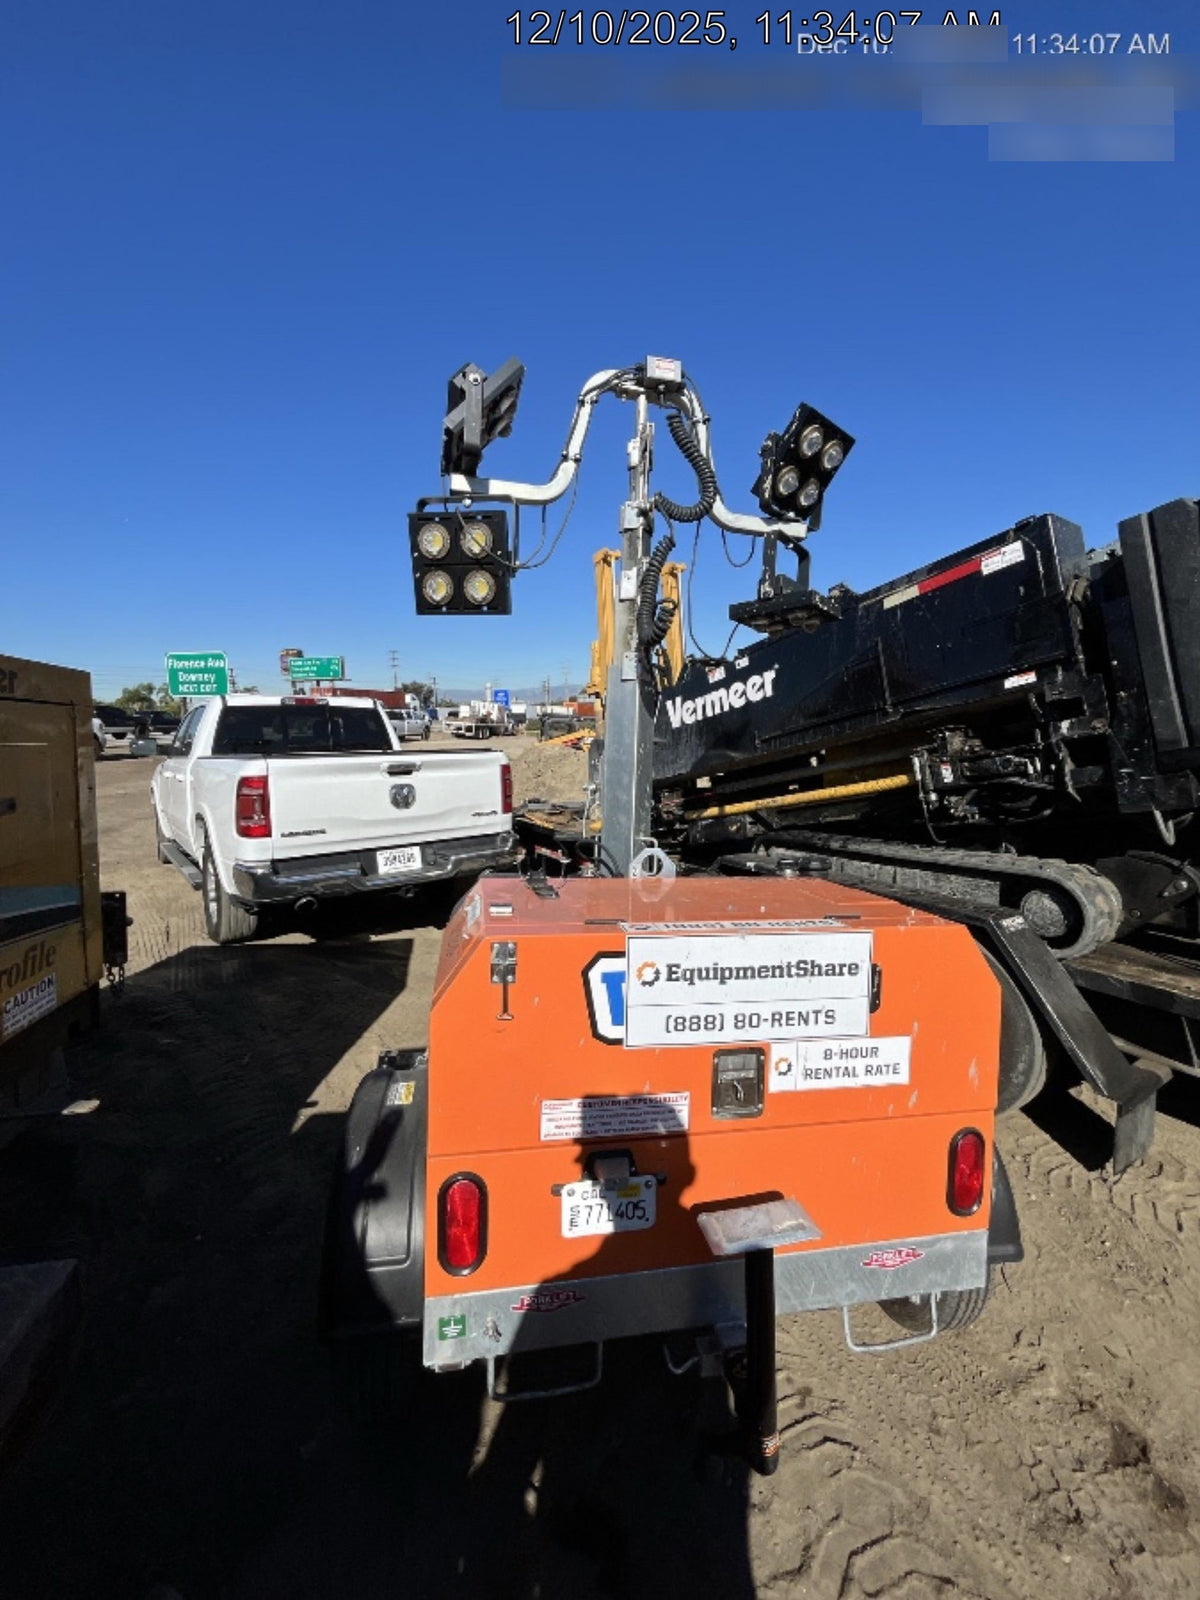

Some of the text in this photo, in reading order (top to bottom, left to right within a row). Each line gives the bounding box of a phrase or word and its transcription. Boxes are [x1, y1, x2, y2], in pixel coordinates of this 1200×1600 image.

[168, 658, 205, 669] Florence
[178, 671, 216, 683] Downey
[665, 669, 777, 729] Vermeer
[665, 960, 860, 986] EquipmentShare
[4, 974, 55, 1014] CAUTION
[664, 1009, 837, 1033] (888) 80-RENTS
[823, 1046, 879, 1061] 8-HOUR
[803, 1063, 901, 1081] RENTAL RATE
